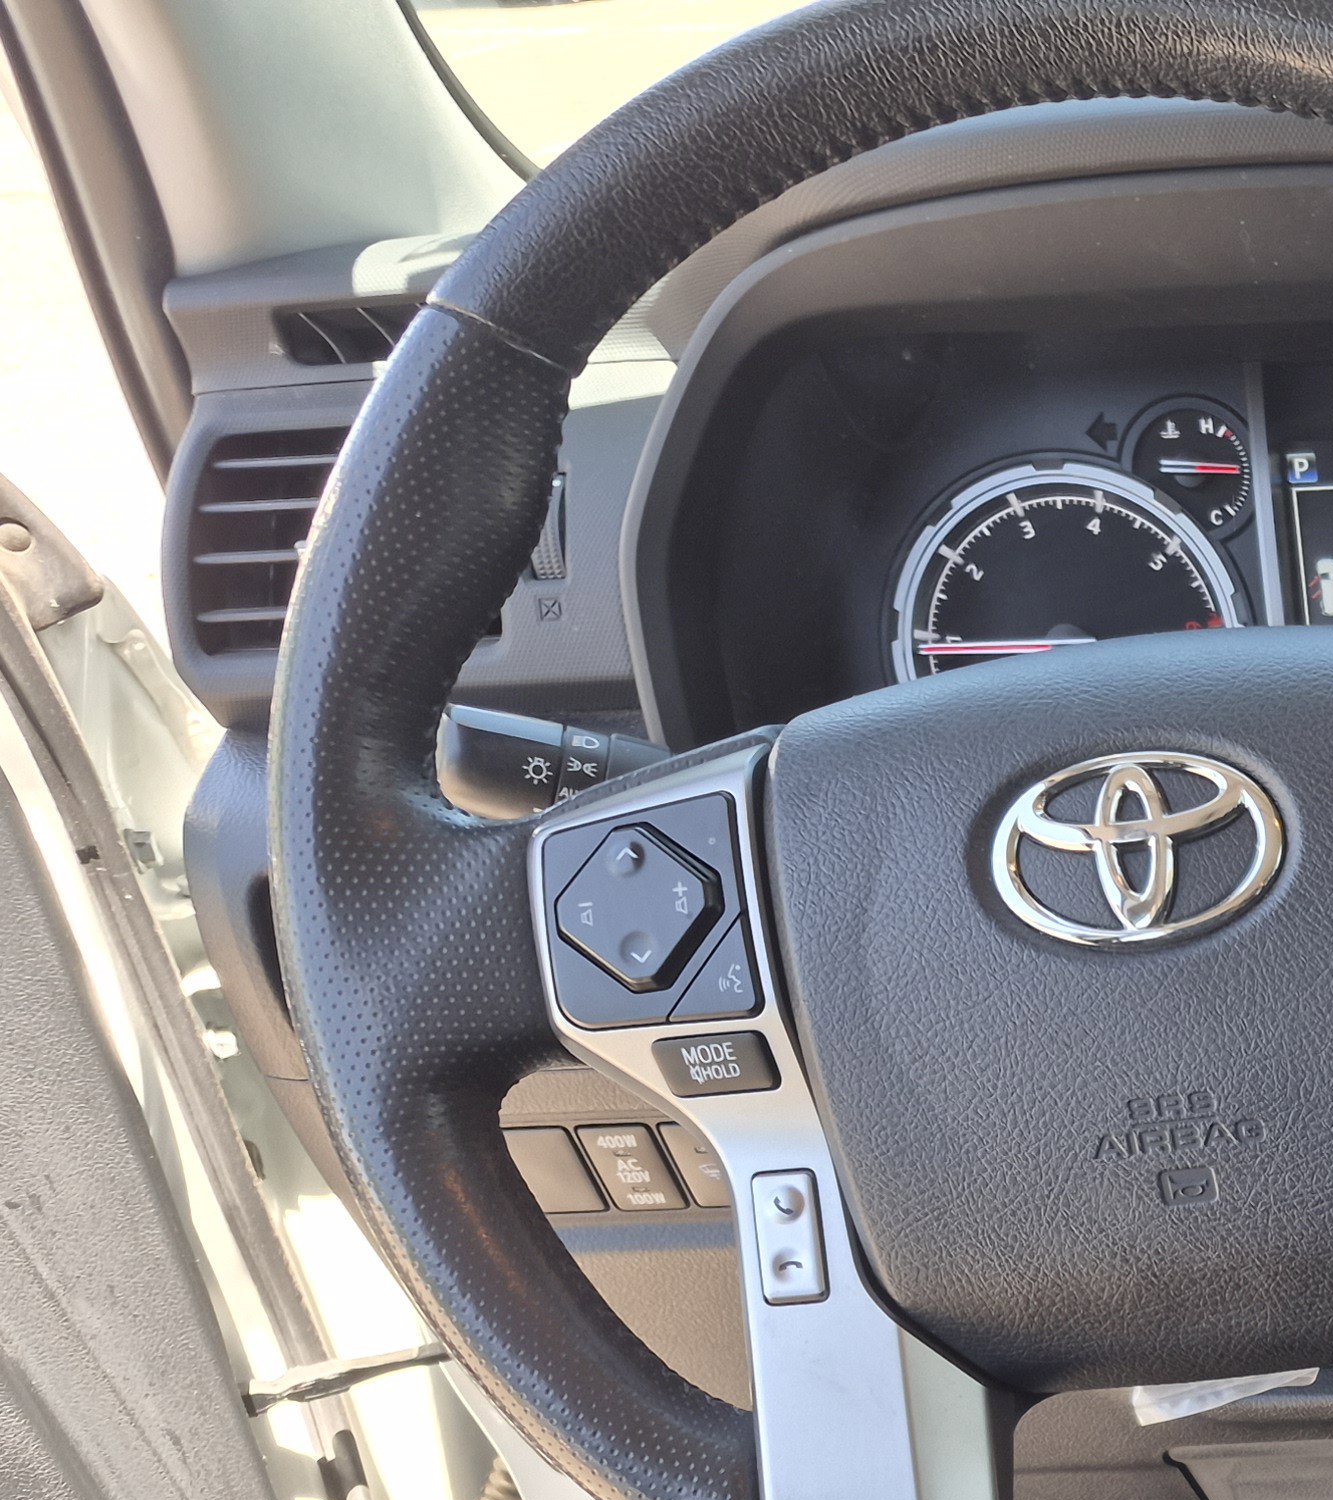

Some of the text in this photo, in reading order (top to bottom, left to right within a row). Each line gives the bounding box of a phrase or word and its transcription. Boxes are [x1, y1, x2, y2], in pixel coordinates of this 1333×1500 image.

[1199, 418, 1213, 434] H
[1294, 457, 1309, 479] P
[1210, 510, 1223, 526] C
[1018, 520, 1036, 539] 3
[1086, 519, 1101, 535] 4
[1149, 553, 1168, 571] 5
[965, 563, 984, 581] 2
[681, 1042, 737, 1065] MODE
[702, 1063, 741, 1081] HOLD
[597, 1134, 637, 1148] 400W
[1094, 1119, 1267, 1160] AIRBAG
[617, 1159, 642, 1171] AC
[616, 1170, 651, 1183] 120V
[627, 1191, 666, 1205] 100W
